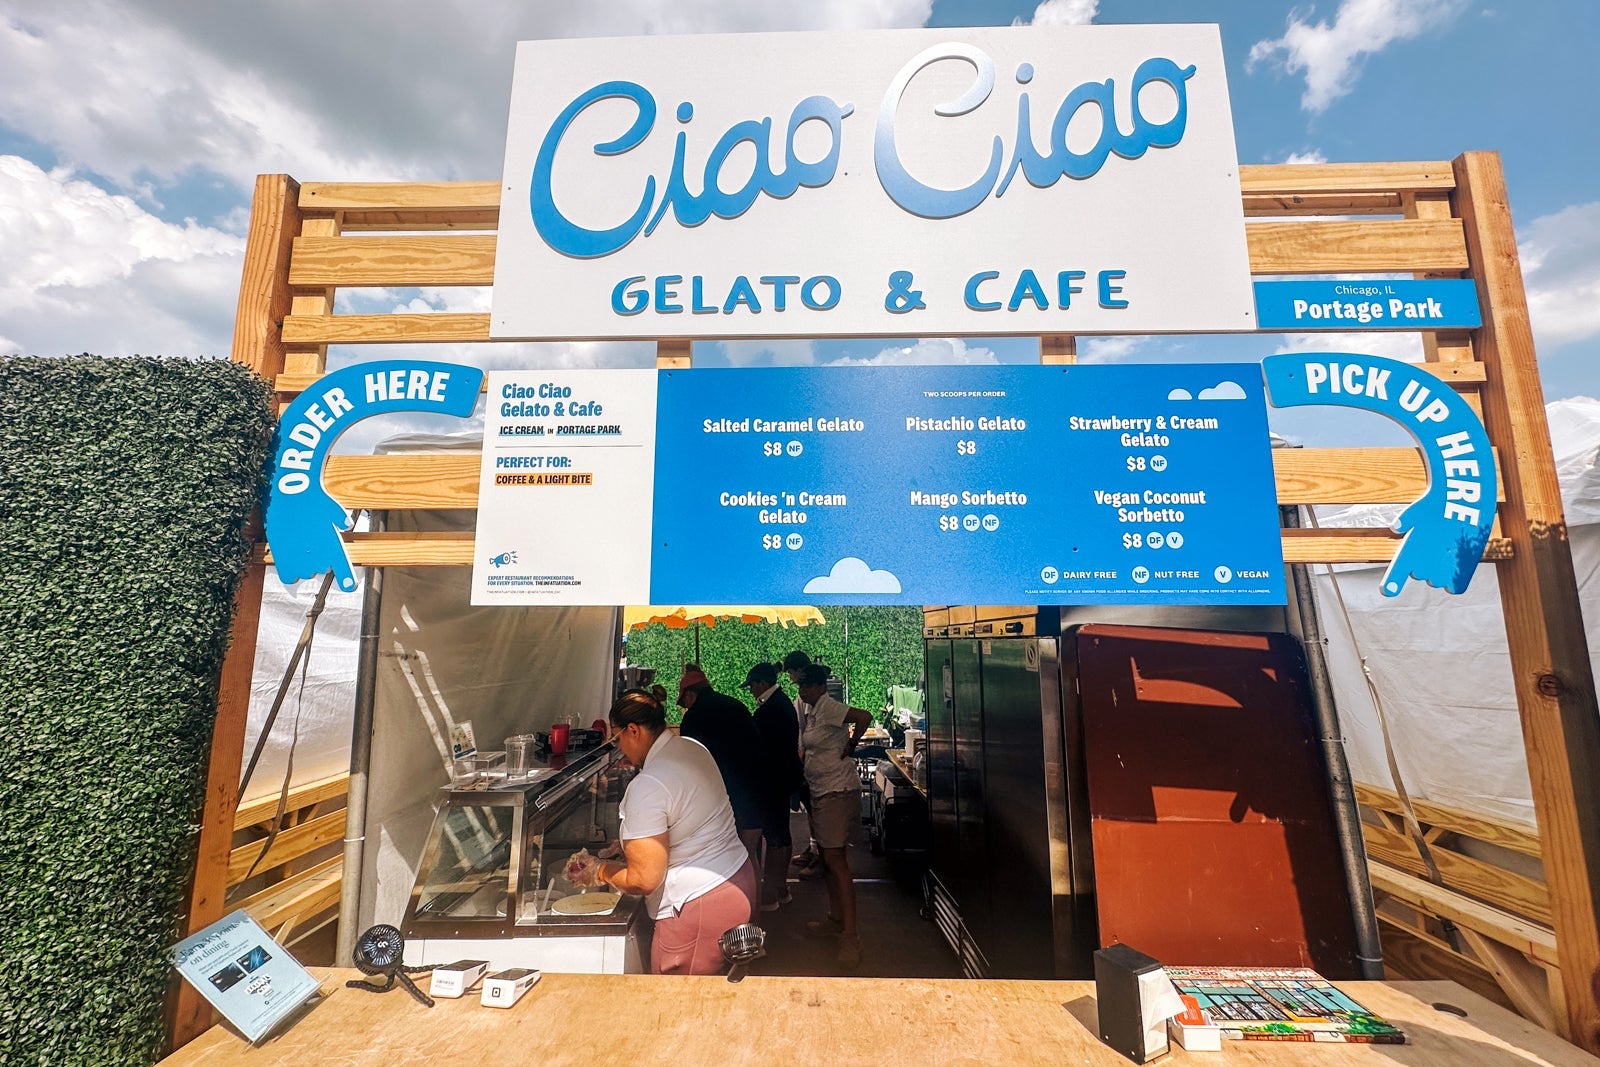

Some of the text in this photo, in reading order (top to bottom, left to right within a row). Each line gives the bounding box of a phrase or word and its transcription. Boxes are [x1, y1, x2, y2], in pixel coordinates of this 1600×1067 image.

[530, 41, 1196, 258] Ciao Ciao
[611, 269, 1130, 316] GELATO & CAFE
[1334, 285, 1396, 296] Chicago, IL
[1293, 298, 1444, 323] Portage Park
[502, 383, 572, 399] Ciao Ciao
[500, 400, 603, 417] Gelato & Cafe
[499, 425, 513, 435] ICE
[515, 425, 544, 435] CREAM
[556, 425, 596, 435] PORTAGE
[597, 425, 621, 434] PARK
[703, 417, 864, 432] Salted Caramel Gelato
[905, 416, 1026, 431] Pistachio Gelato
[1069, 415, 1219, 431] Strawberry & Cream
[278, 369, 450, 495] ORDER HERE
[1120, 432, 1170, 447] Gelato
[763, 441, 801, 457] $8 NF
[957, 440, 976, 455] $8
[1304, 362, 1482, 526] PICK UP HERE
[496, 456, 572, 468] PERFECT FOR:
[1126, 456, 1165, 472] $8 NF
[496, 475, 591, 484] COFFEE & A LIGHT BITE
[719, 491, 778, 506] Cookies
[799, 492, 847, 506] Cream
[910, 491, 1027, 508] Mango Sorbetto
[1093, 490, 1206, 508] Vegan Coconut
[759, 509, 808, 524] Gelato
[939, 515, 997, 531] $8 DF NF
[1118, 507, 1185, 523] Sorbetto
[762, 534, 801, 550] $8 NF
[1122, 533, 1142, 549] $8
[1149, 536, 1161, 545] DF
[1044, 571, 1117, 579] DF DAIRY FREE
[1134, 571, 1147, 579] NF
[1154, 571, 1173, 579] NUT
[1236, 570, 1269, 578] VEGAN
[203, 940, 230, 958] dining
